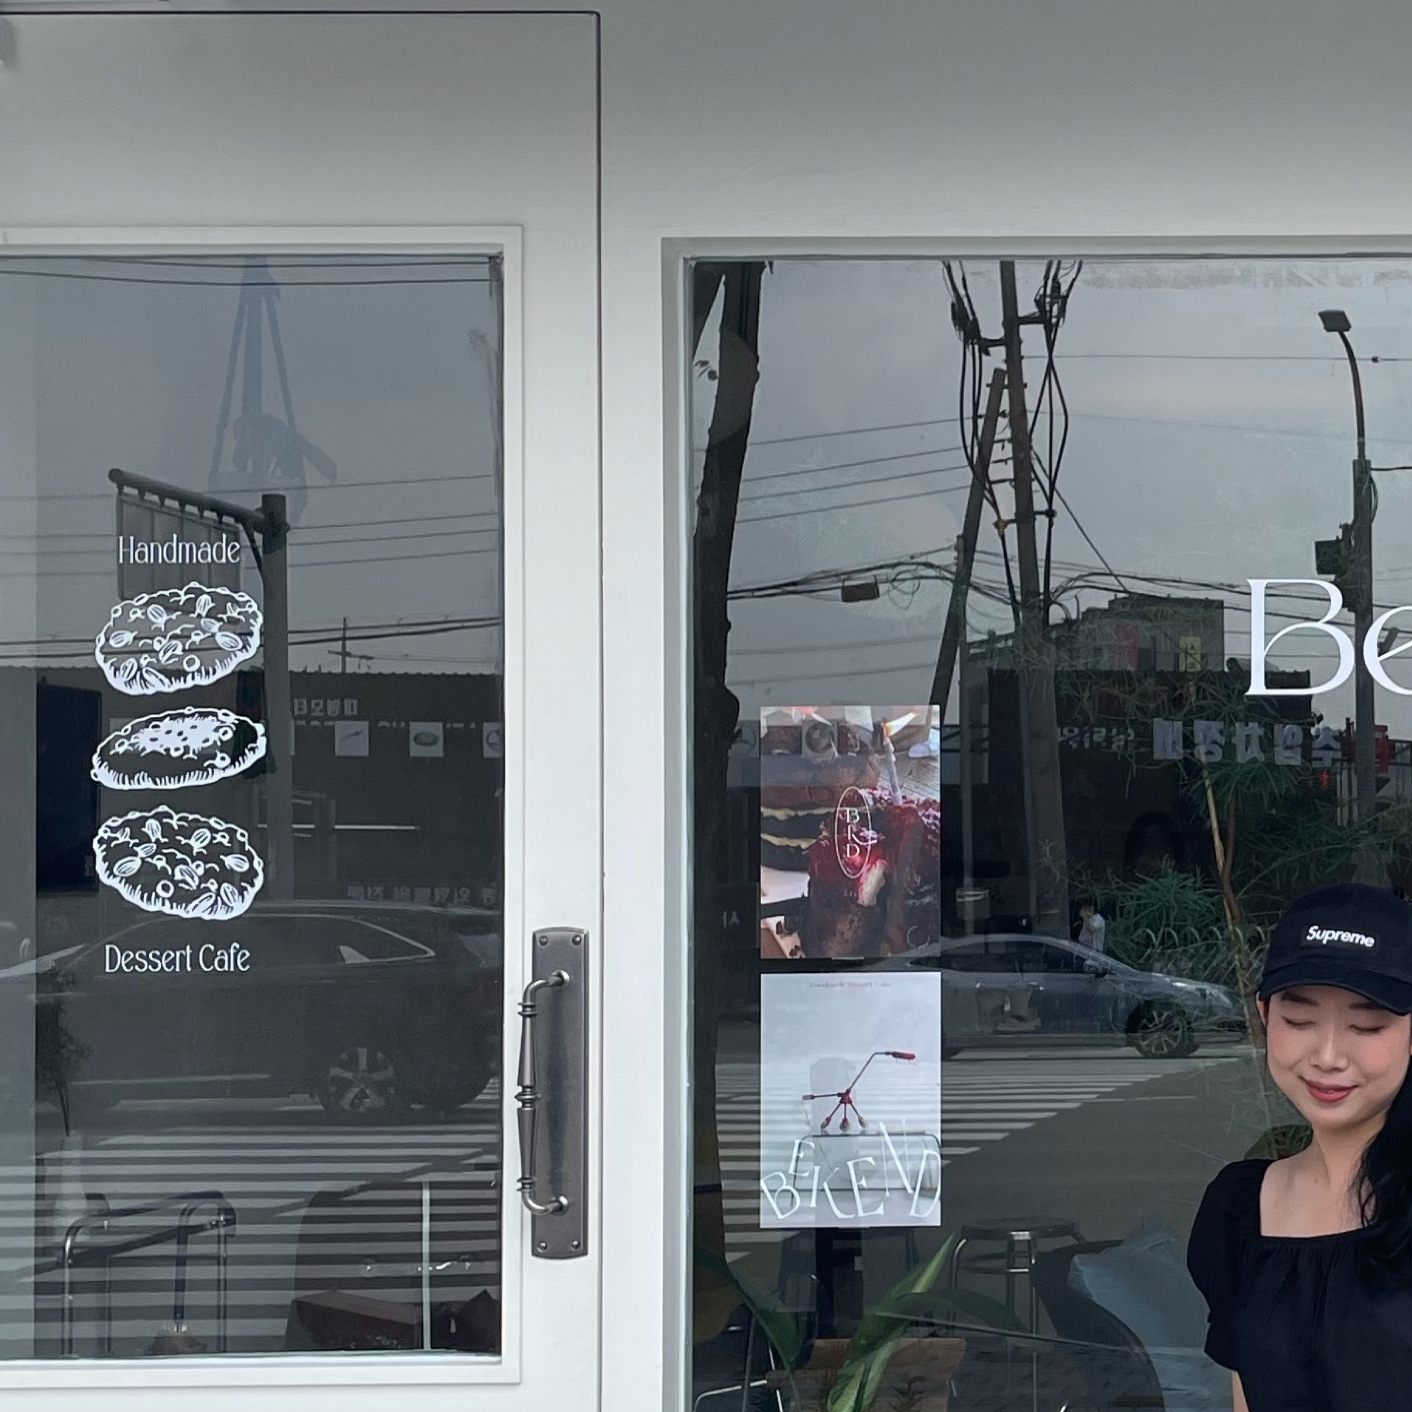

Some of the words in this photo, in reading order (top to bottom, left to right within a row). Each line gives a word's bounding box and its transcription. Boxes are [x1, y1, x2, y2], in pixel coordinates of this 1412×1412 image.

[118, 533, 241, 565] Handmade
[1305, 925, 1376, 949] Supreme
[104, 944, 192, 973] Dessert
[198, 942, 250, 973] Cafe
[761, 1119, 941, 1220] BEKEND
